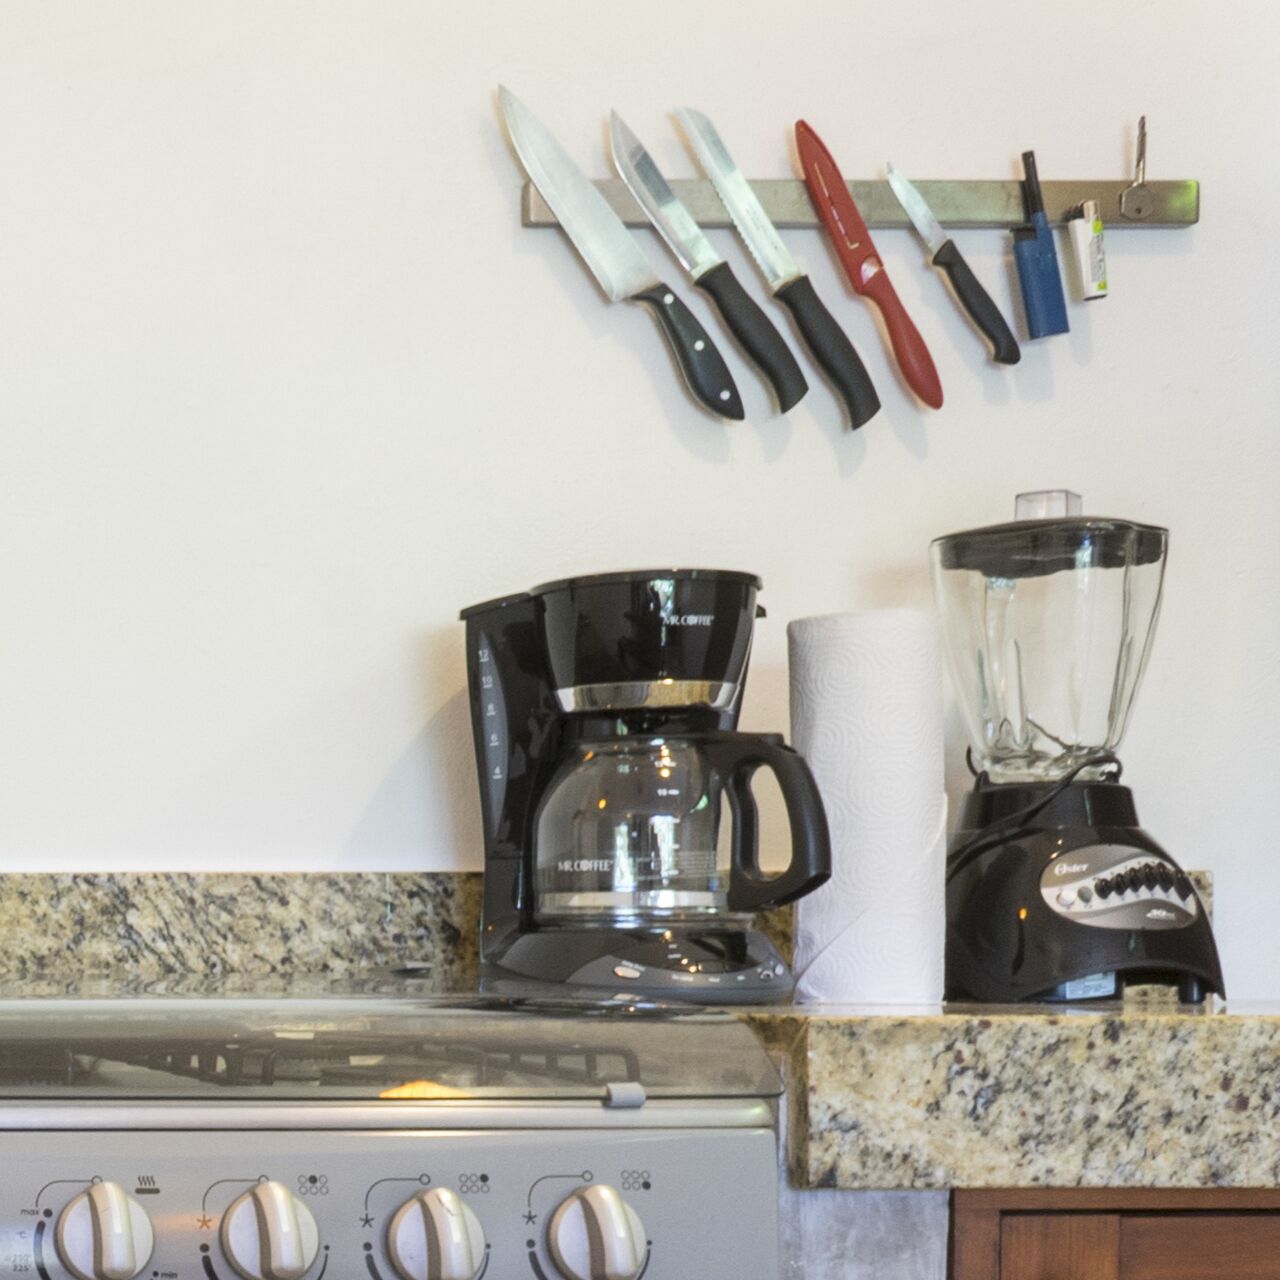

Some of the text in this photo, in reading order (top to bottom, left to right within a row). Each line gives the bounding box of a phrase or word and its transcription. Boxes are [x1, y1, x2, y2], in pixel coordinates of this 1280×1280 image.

[478, 649, 489, 660] 12
[482, 675, 493, 685] 10
[494, 766, 500, 774] 4
[1054, 863, 1089, 876] Oster
[20, 1208, 39, 1216] max
